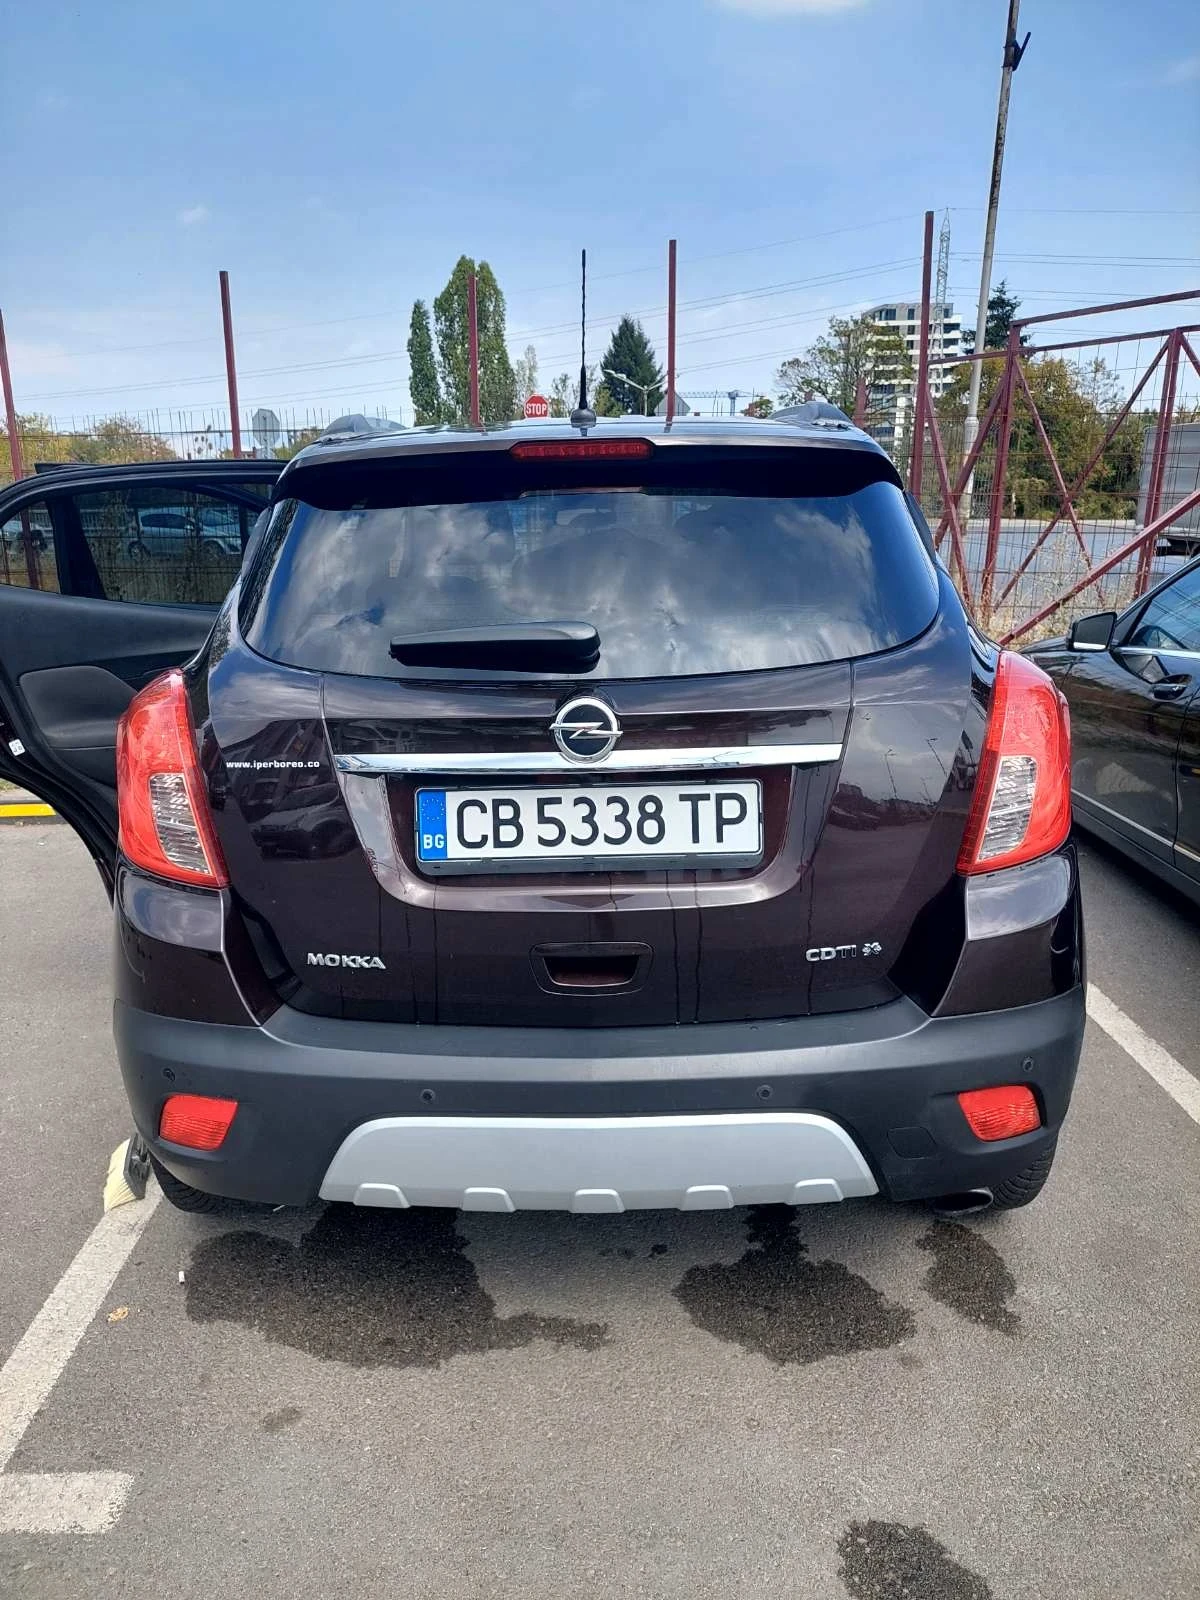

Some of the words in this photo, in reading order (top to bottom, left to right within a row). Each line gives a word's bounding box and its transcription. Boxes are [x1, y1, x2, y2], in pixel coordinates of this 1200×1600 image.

[526, 403, 547, 415] STOP
[456, 798, 524, 849] CB
[536, 794, 665, 847] 5338
[679, 792, 748, 843] TP
[422, 834, 445, 849] BG
[307, 952, 386, 969] MOKKA
[805, 944, 857, 962] CDTI
